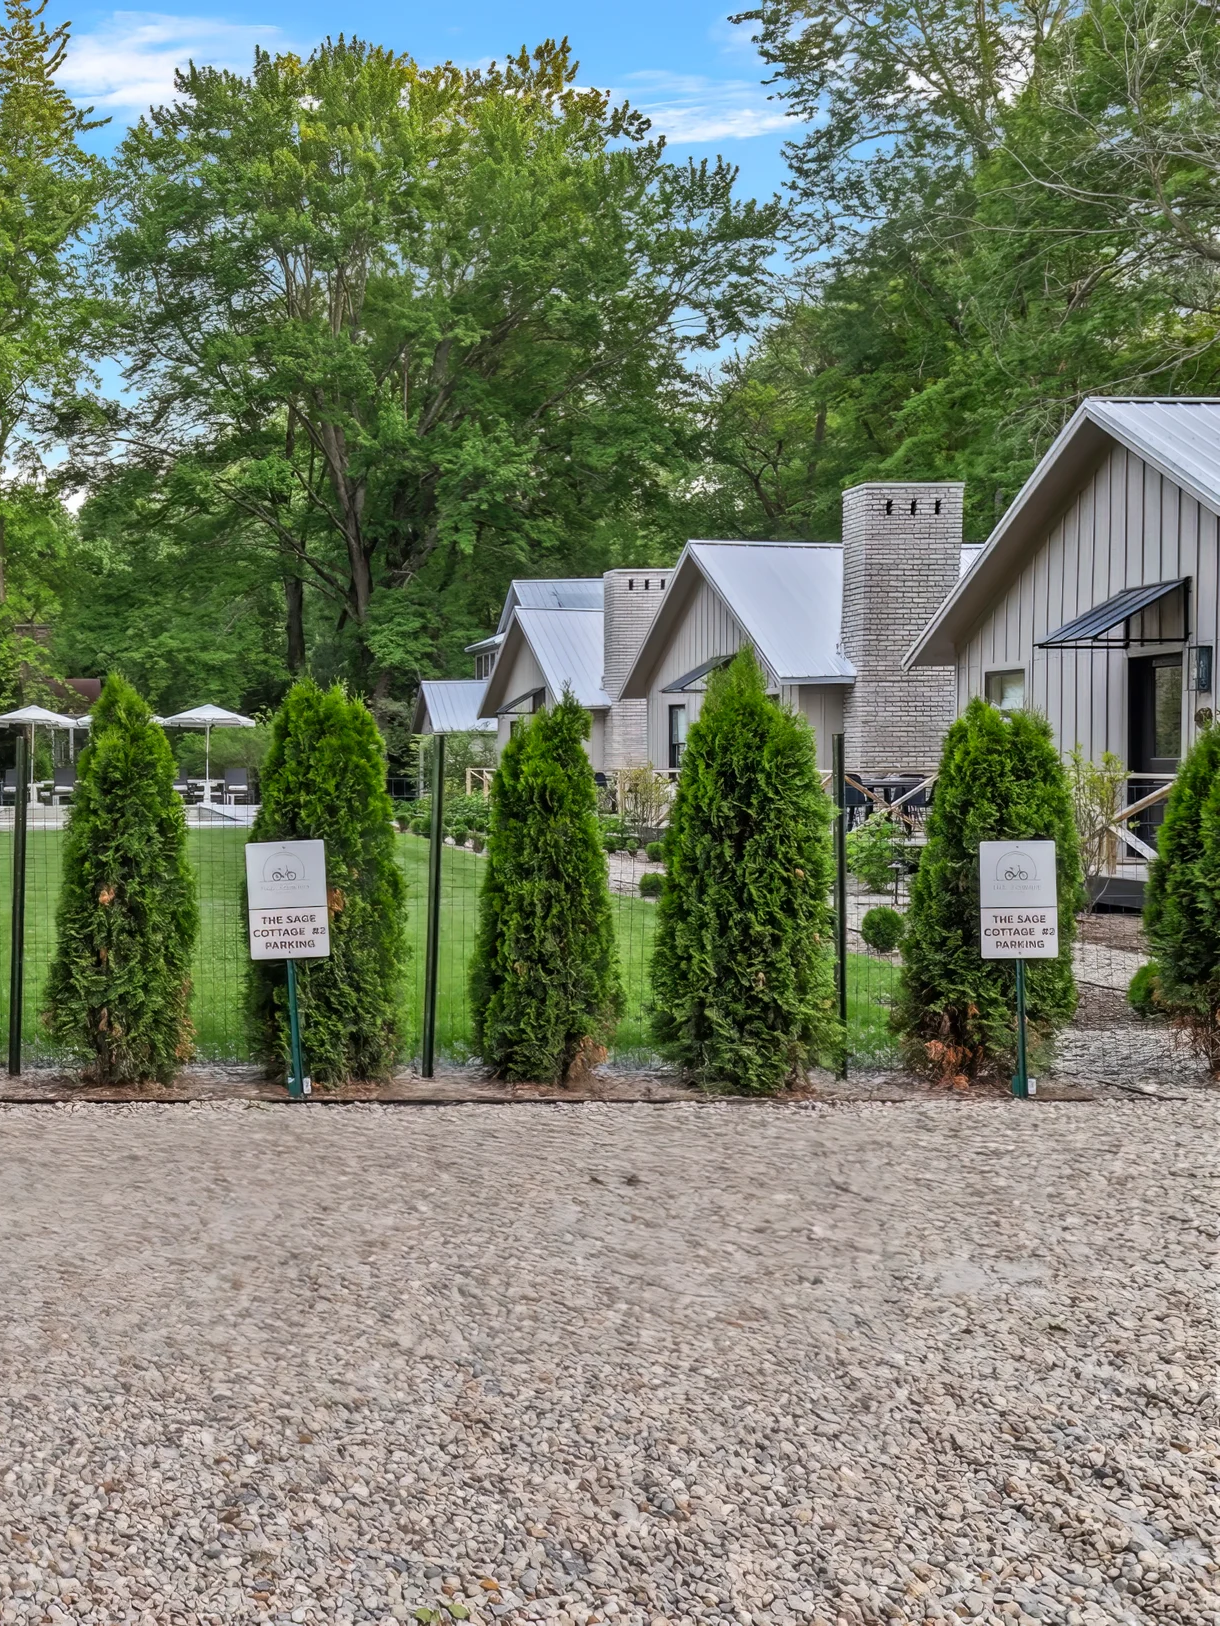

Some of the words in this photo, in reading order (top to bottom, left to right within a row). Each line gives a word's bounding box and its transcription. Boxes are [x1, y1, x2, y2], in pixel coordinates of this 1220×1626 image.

[261, 916, 283, 925] THE
[286, 914, 317, 924] SAGE
[992, 915, 1014, 924] THE
[1017, 914, 1046, 924] SAGE
[253, 927, 306, 938] COTTAGE
[984, 927, 1036, 937] COTTAGE
[265, 940, 316, 950] PARKING
[995, 940, 1045, 949] PARKING
